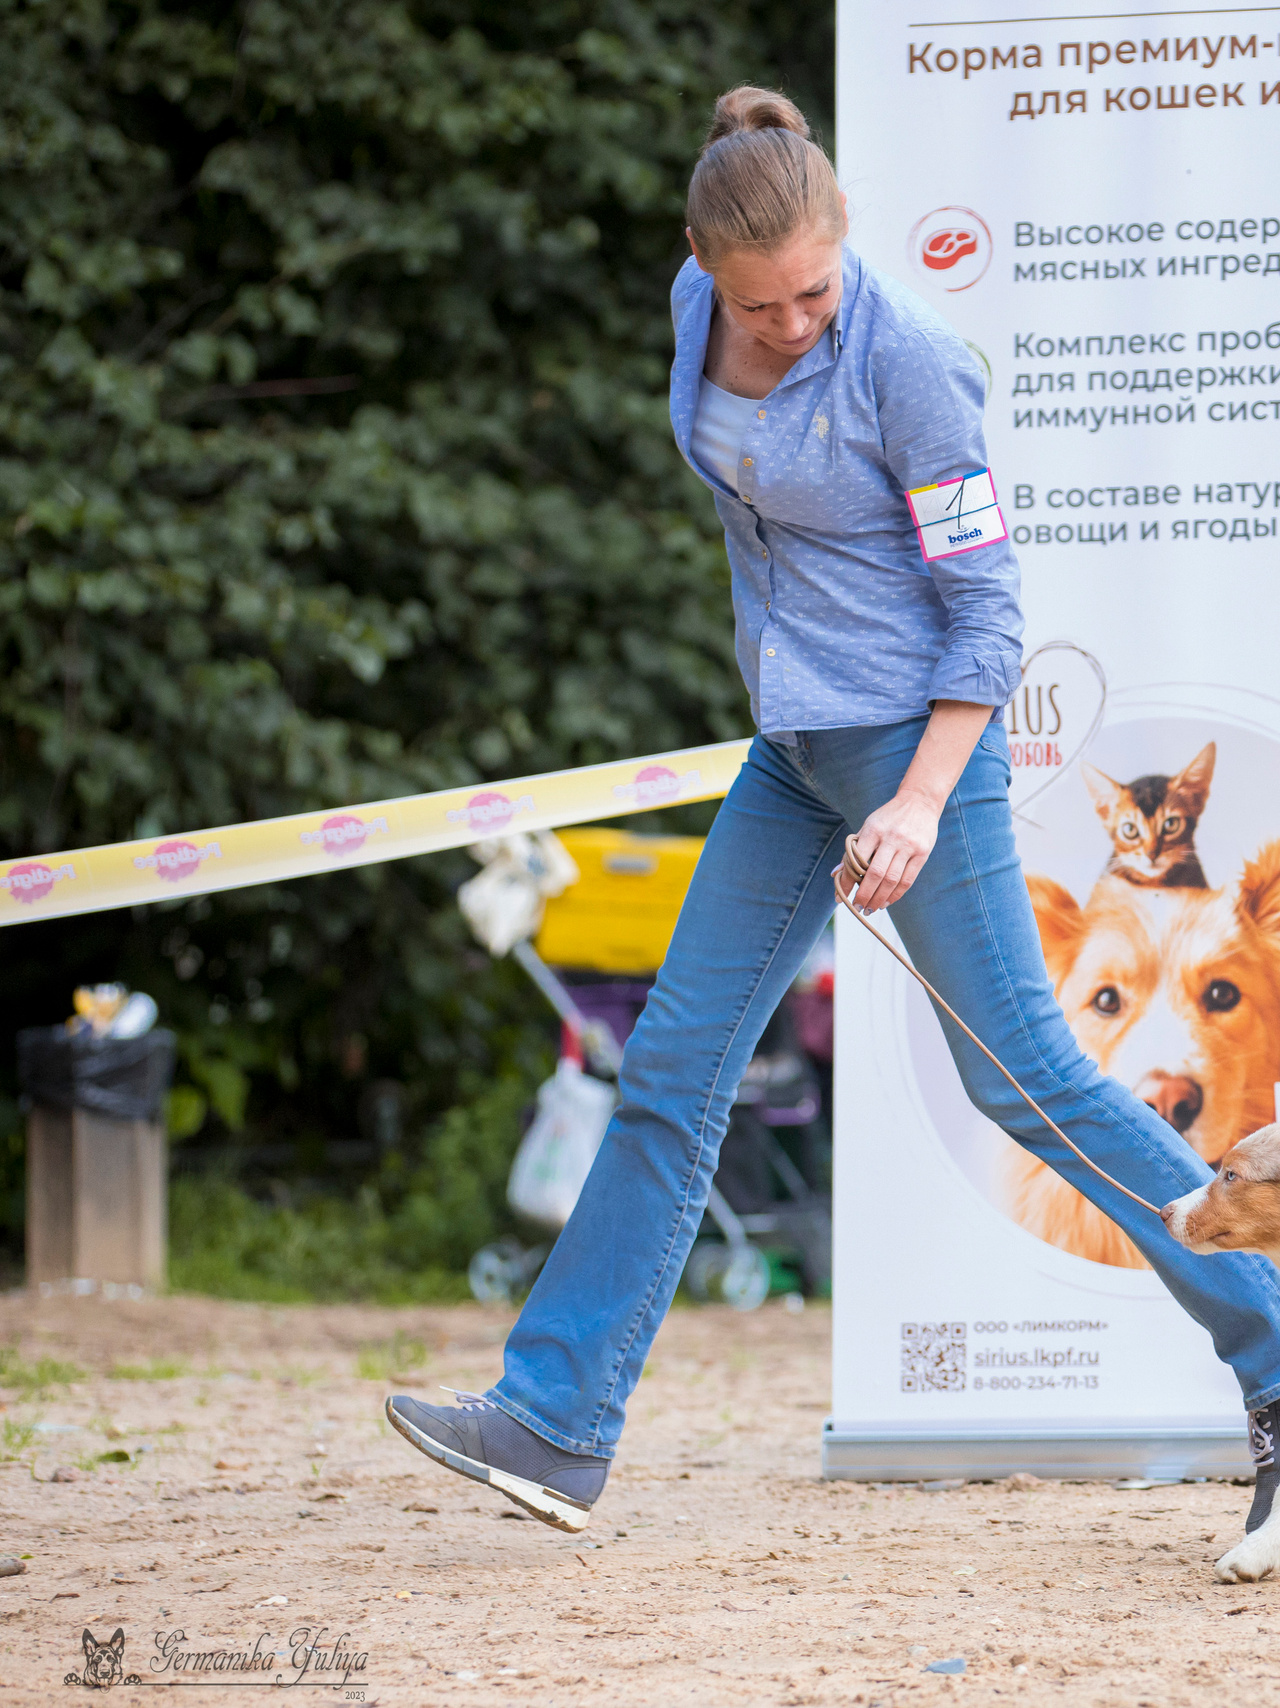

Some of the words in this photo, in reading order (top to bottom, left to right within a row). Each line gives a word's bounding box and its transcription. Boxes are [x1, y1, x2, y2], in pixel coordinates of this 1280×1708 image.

[907, 40, 1043, 80] Корма
[1009, 86, 1088, 121] для
[1104, 77, 1246, 112] кошек
[1014, 215, 1165, 247] Высокое
[1013, 254, 1147, 283] мясных
[1014, 326, 1187, 358] Комплекс
[1012, 370, 1075, 397] для
[1013, 397, 1196, 432] иммунной
[1013, 483, 1035, 509] В
[1047, 481, 1181, 507] составе
[947, 527, 983, 544] bosch
[1012, 519, 1127, 546] овощи
[1140, 520, 1159, 541] и
[1171, 514, 1277, 543] ягоды
[1008, 683, 1062, 736] IUS
[1009, 741, 1063, 767] ЮБОВЬ
[973, 1320, 1008, 1334] ООО
[1013, 1320, 1109, 1333] «ЛИМКОРМ»
[974, 1347, 1100, 1367] sirius.lkpf.ru
[973, 1375, 1099, 1390] 8-800-234-71-13
